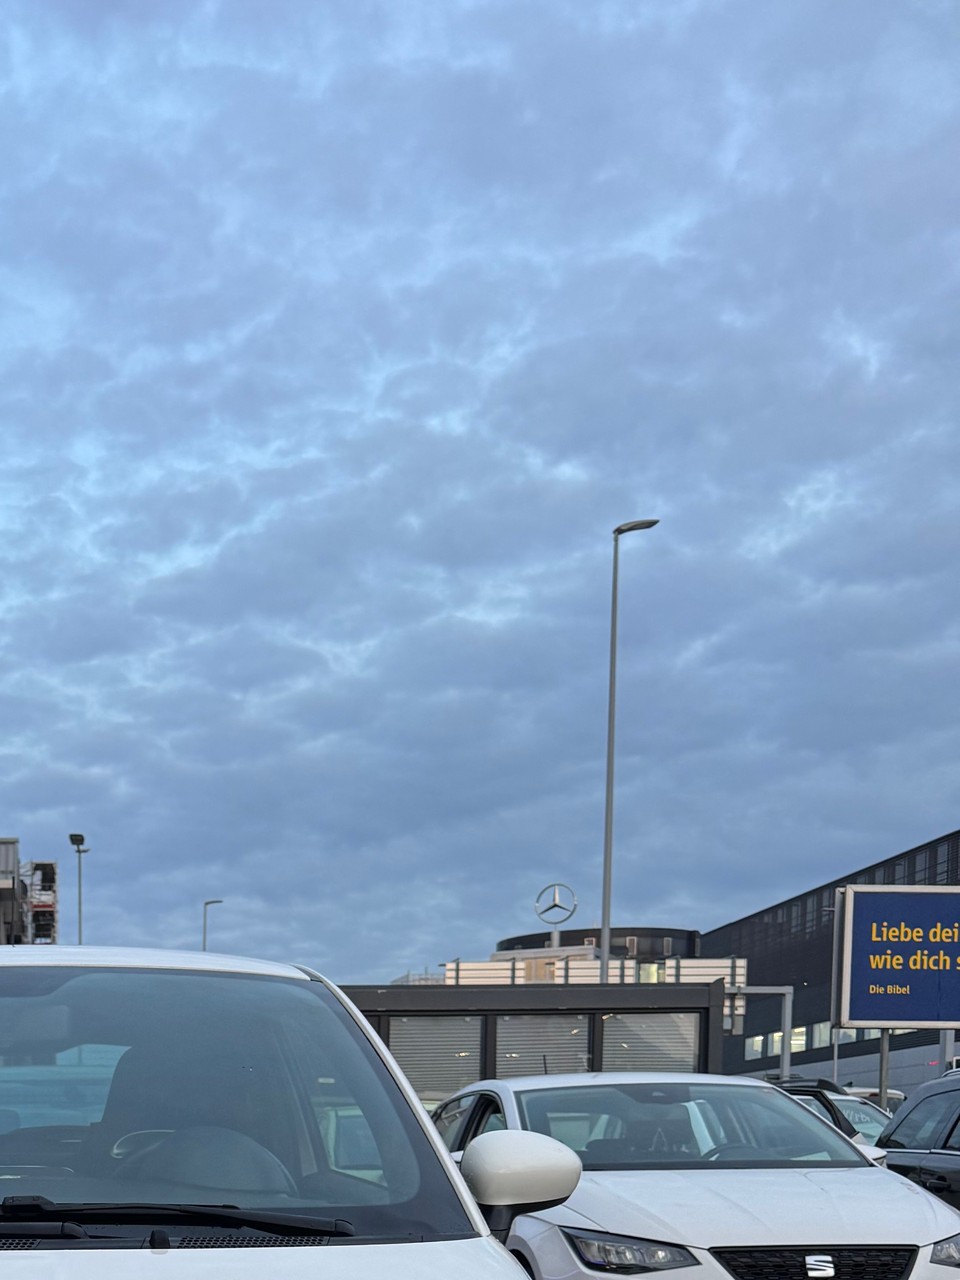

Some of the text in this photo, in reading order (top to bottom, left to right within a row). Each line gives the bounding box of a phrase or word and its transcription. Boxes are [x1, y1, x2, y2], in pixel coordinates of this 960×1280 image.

[871, 922, 924, 942] Liebe
[869, 949, 904, 970] wie
[908, 950, 951, 970] dich
[869, 984, 911, 995] Die Bibel
